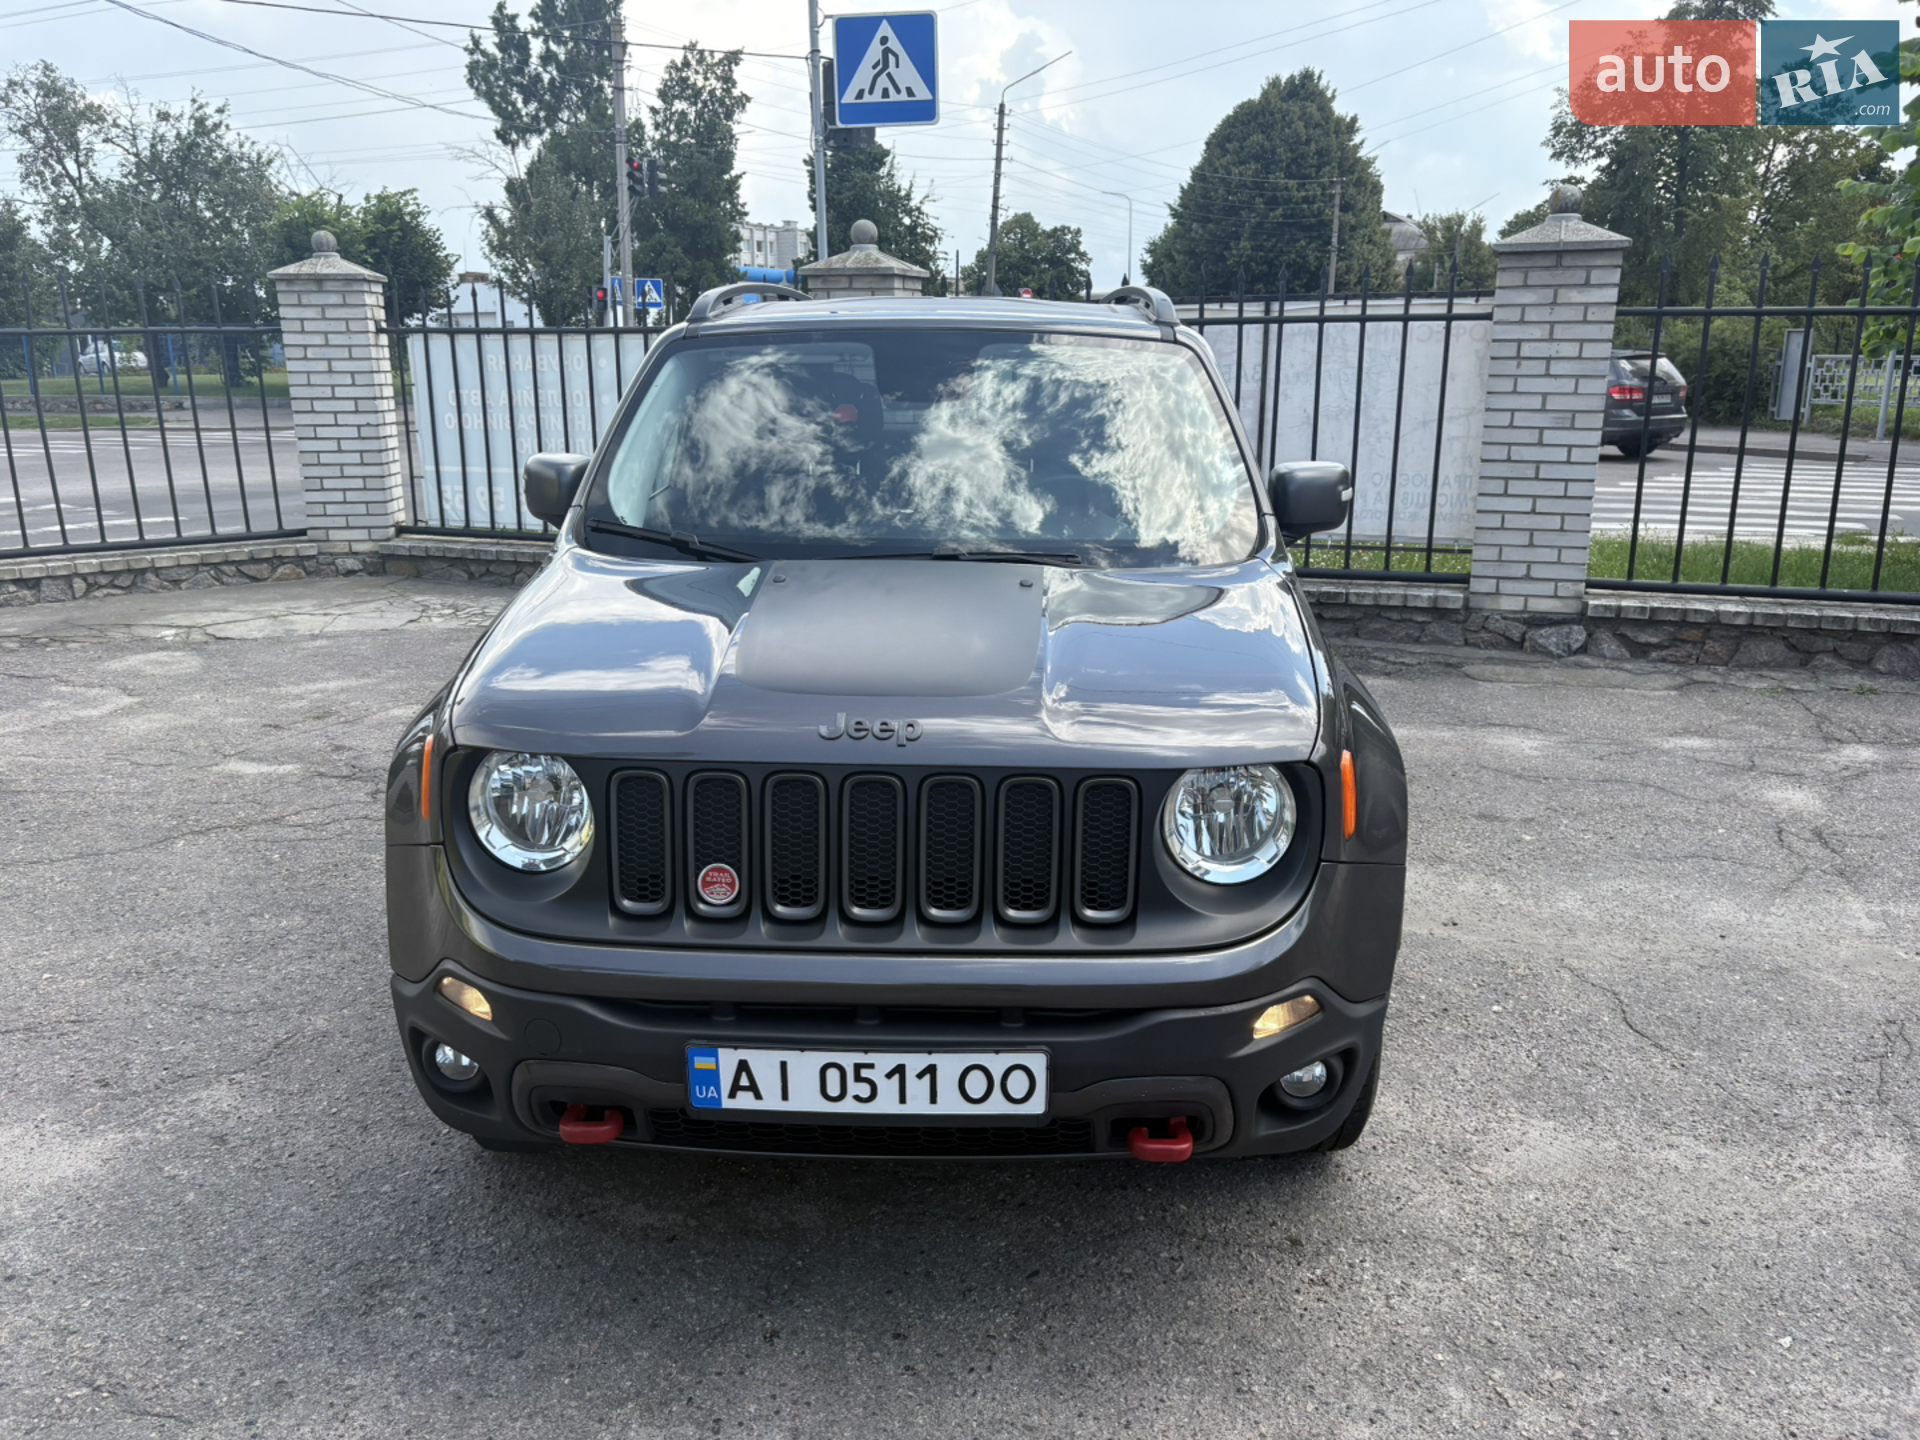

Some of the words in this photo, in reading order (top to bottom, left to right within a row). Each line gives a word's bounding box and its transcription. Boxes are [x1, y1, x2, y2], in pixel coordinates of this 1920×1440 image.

[817, 712, 923, 747] Jeep
[695, 1085, 719, 1099] UA
[819, 1062, 939, 1104] 0511
